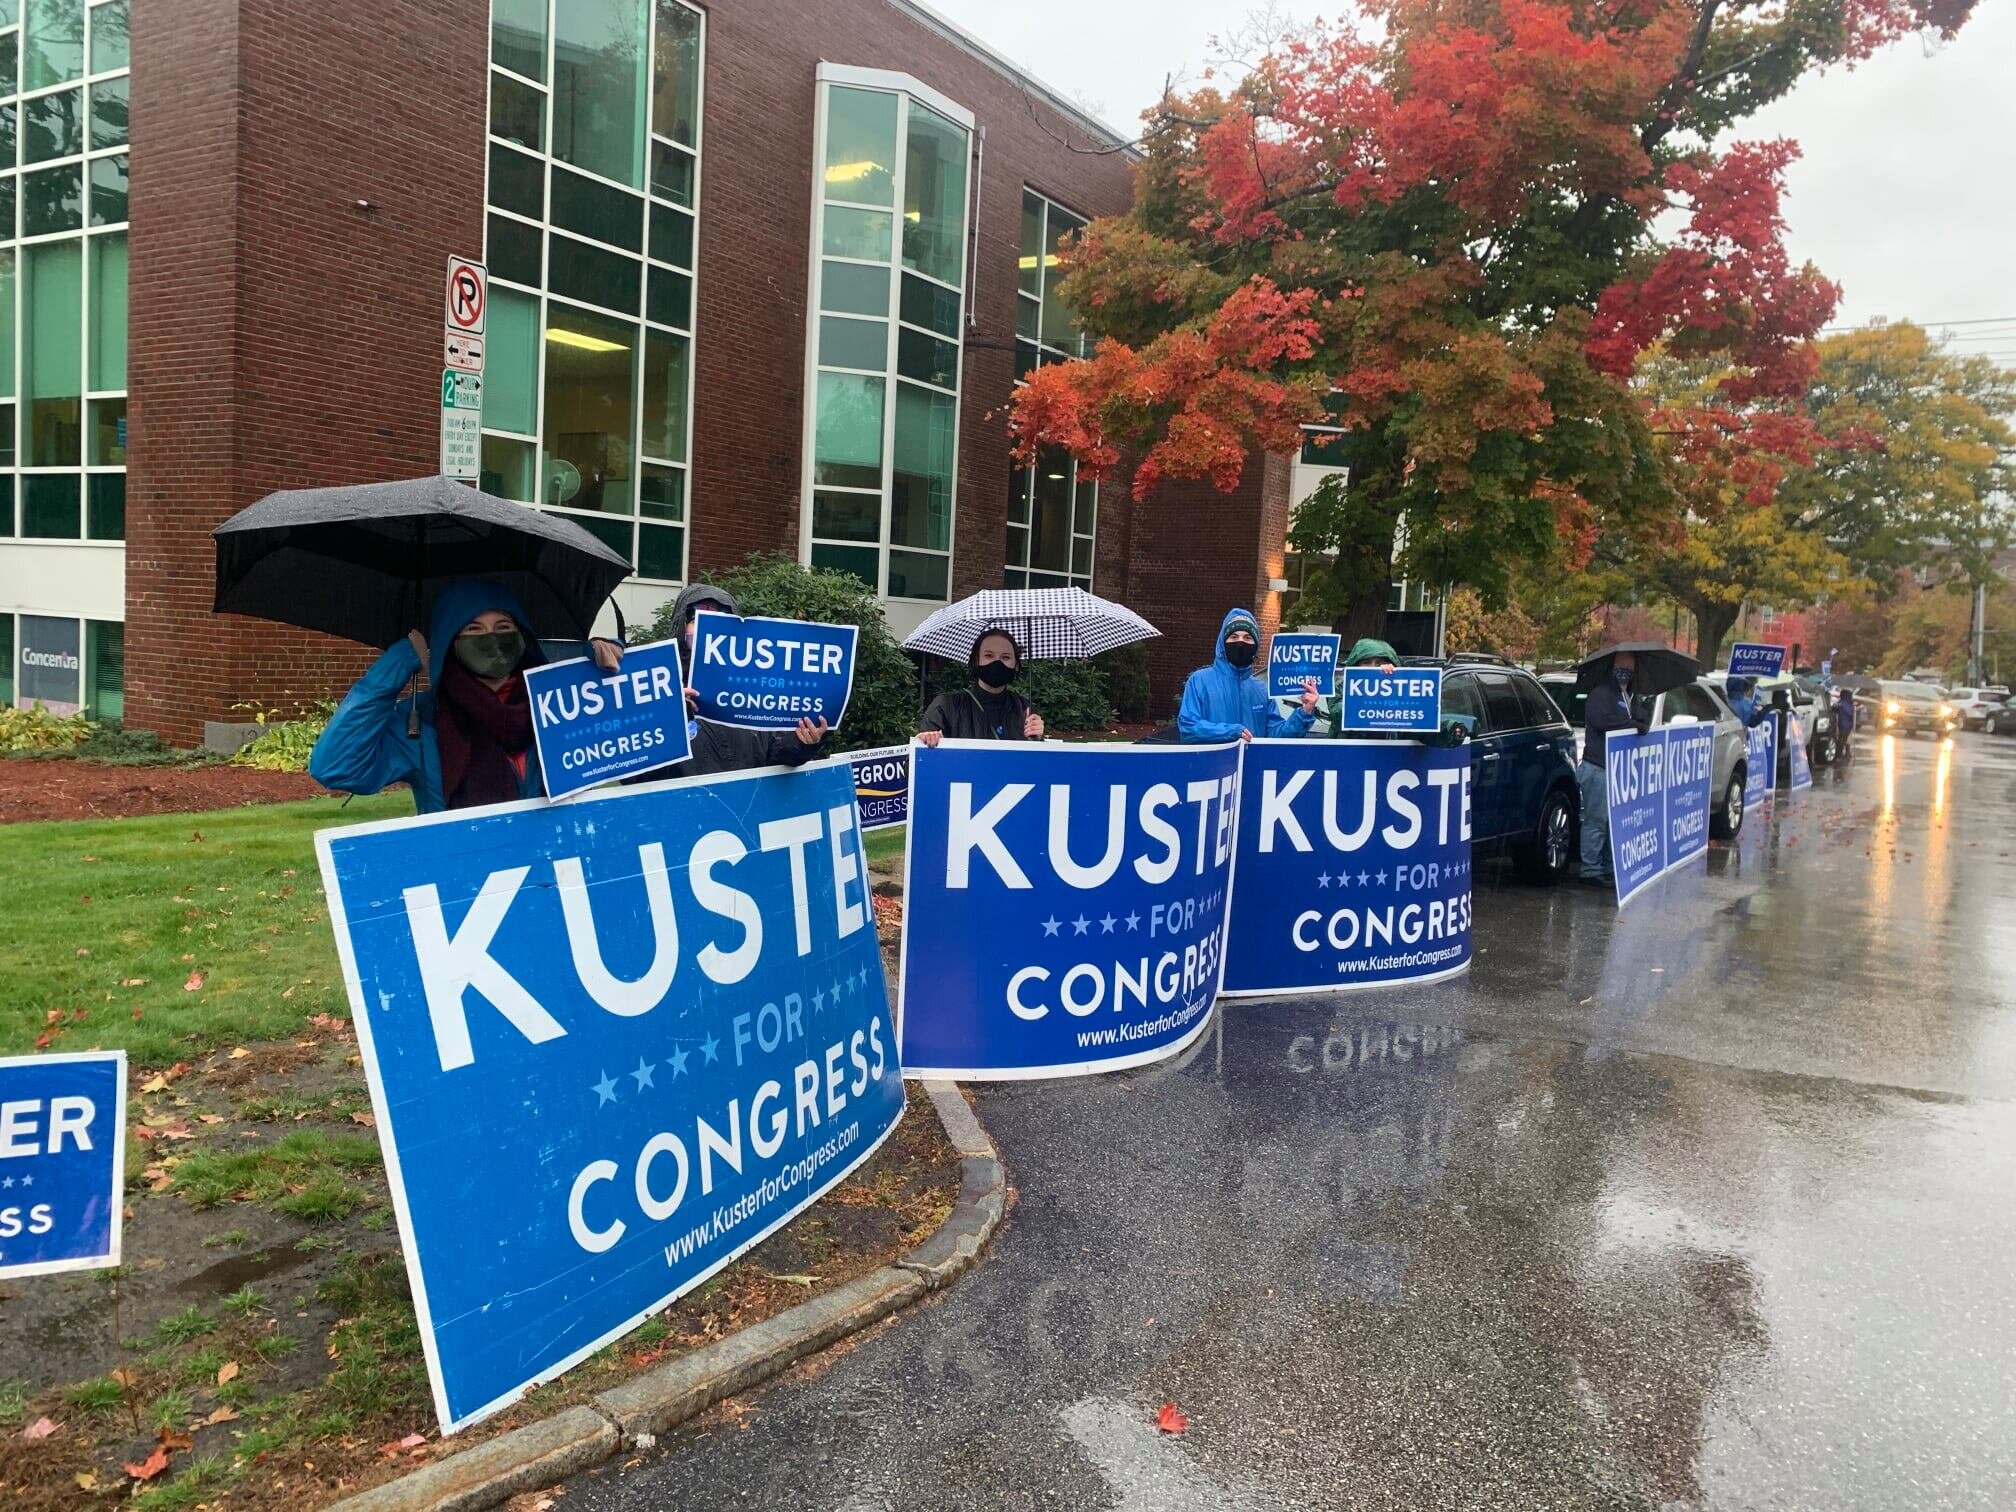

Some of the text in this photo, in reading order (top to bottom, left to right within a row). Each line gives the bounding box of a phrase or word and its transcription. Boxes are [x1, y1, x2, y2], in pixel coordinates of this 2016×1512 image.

[445, 376, 454, 402] 2
[456, 391, 480, 407] PARKING
[704, 633, 844, 674] KUSTER
[1273, 645, 1332, 663] KUSTER
[1734, 648, 1782, 662] KUSTER
[537, 666, 674, 728] KUSTER
[761, 677, 786, 688] FOR
[1350, 678, 1434, 697] KUSTER
[716, 691, 823, 712] CONGRESS
[1358, 710, 1424, 720] CONGRESS
[594, 718, 622, 735] FOR
[562, 728, 664, 770] CONGRESS
[1668, 736, 1711, 789] KUSTER
[1610, 743, 1664, 807] KUSTER
[1672, 808, 1704, 843] CONGRESS
[1621, 830, 1658, 871] CONGRESS
[1395, 863, 1439, 892] FOR
[1150, 898, 1194, 938] FOR
[1006, 924, 1220, 1020] CONGRESS
[1338, 944, 1462, 973] www.KusterforCongress.com
[732, 992, 804, 1067] FOR
[568, 1014, 884, 1254] CONGRESS
[664, 1118, 860, 1268] www.KusterforCongress.com
